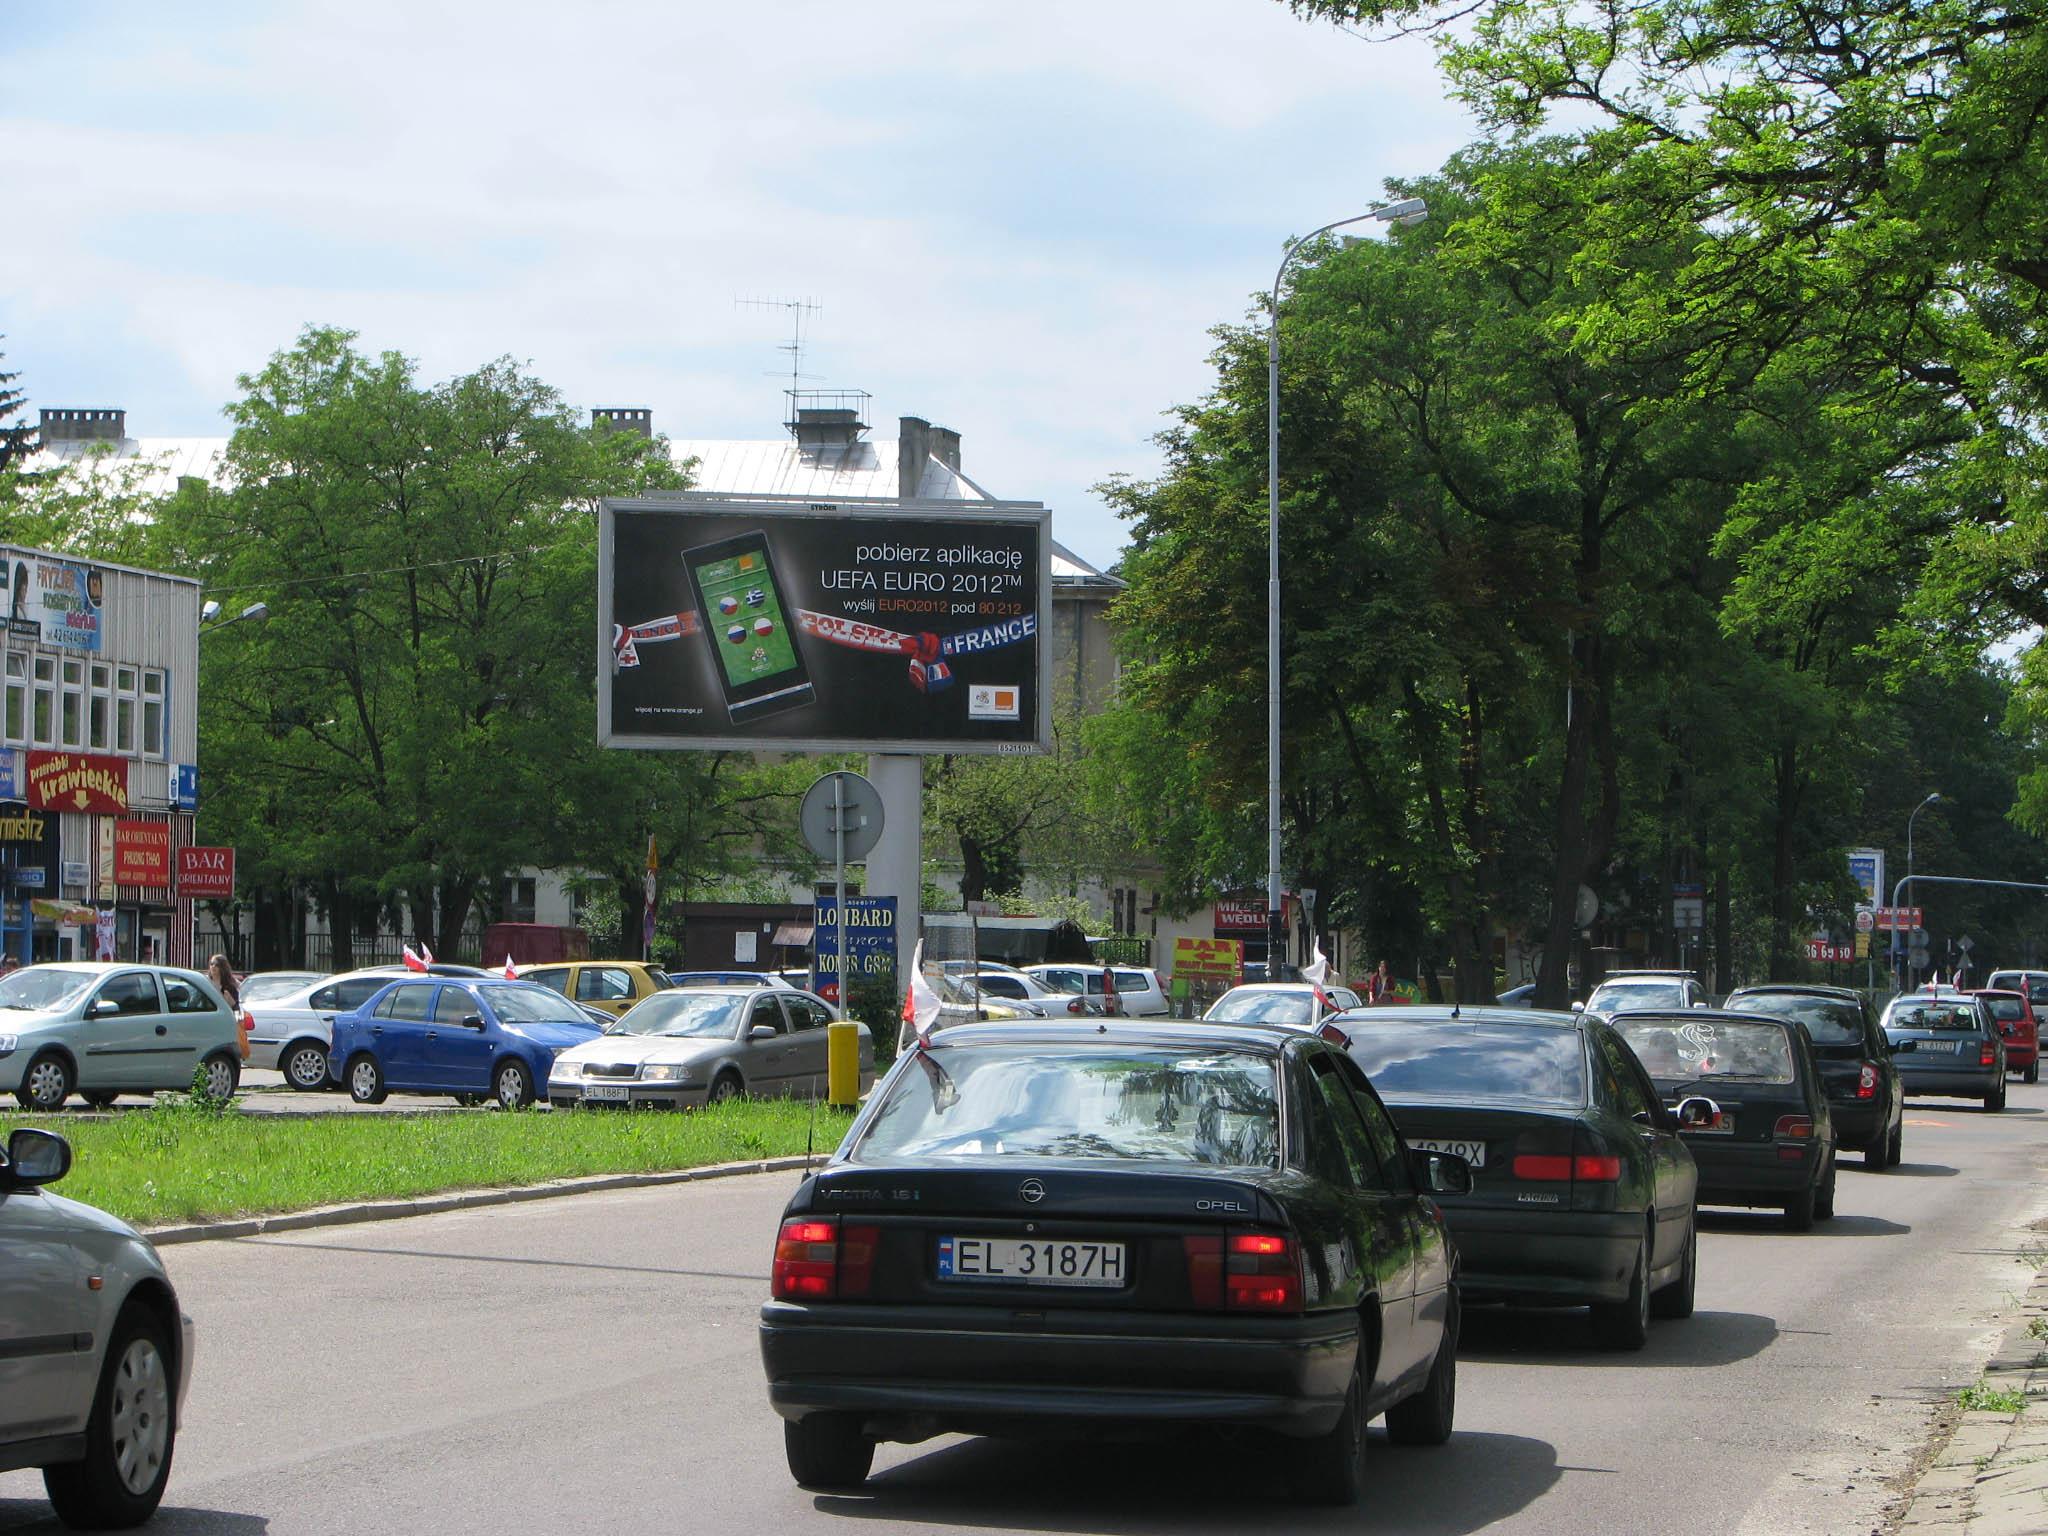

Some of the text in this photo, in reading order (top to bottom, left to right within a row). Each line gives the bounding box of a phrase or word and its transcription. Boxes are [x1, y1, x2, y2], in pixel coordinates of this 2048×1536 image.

[856, 543, 1023, 570] pobierz aplikację
[821, 570, 877, 590] UEFA
[884, 572, 945, 592] EURO
[843, 599, 1021, 616] wyślij EURO2012 pod 80 212
[801, 612, 902, 649] POLSKA
[954, 615, 1036, 654] FRANCE
[39, 759, 128, 809] krawieckie
[185, 851, 225, 871] BAR
[178, 873, 231, 886] ORIENTALNY
[1176, 938, 1232, 953] BAR
[587, 1087, 627, 1098] EL 188FT
[820, 1187, 883, 1200] VECTRA
[1195, 1198, 1248, 1213] OPEL
[940, 1259, 951, 1269] PL
[958, 1241, 1121, 1279] EL 3187H
